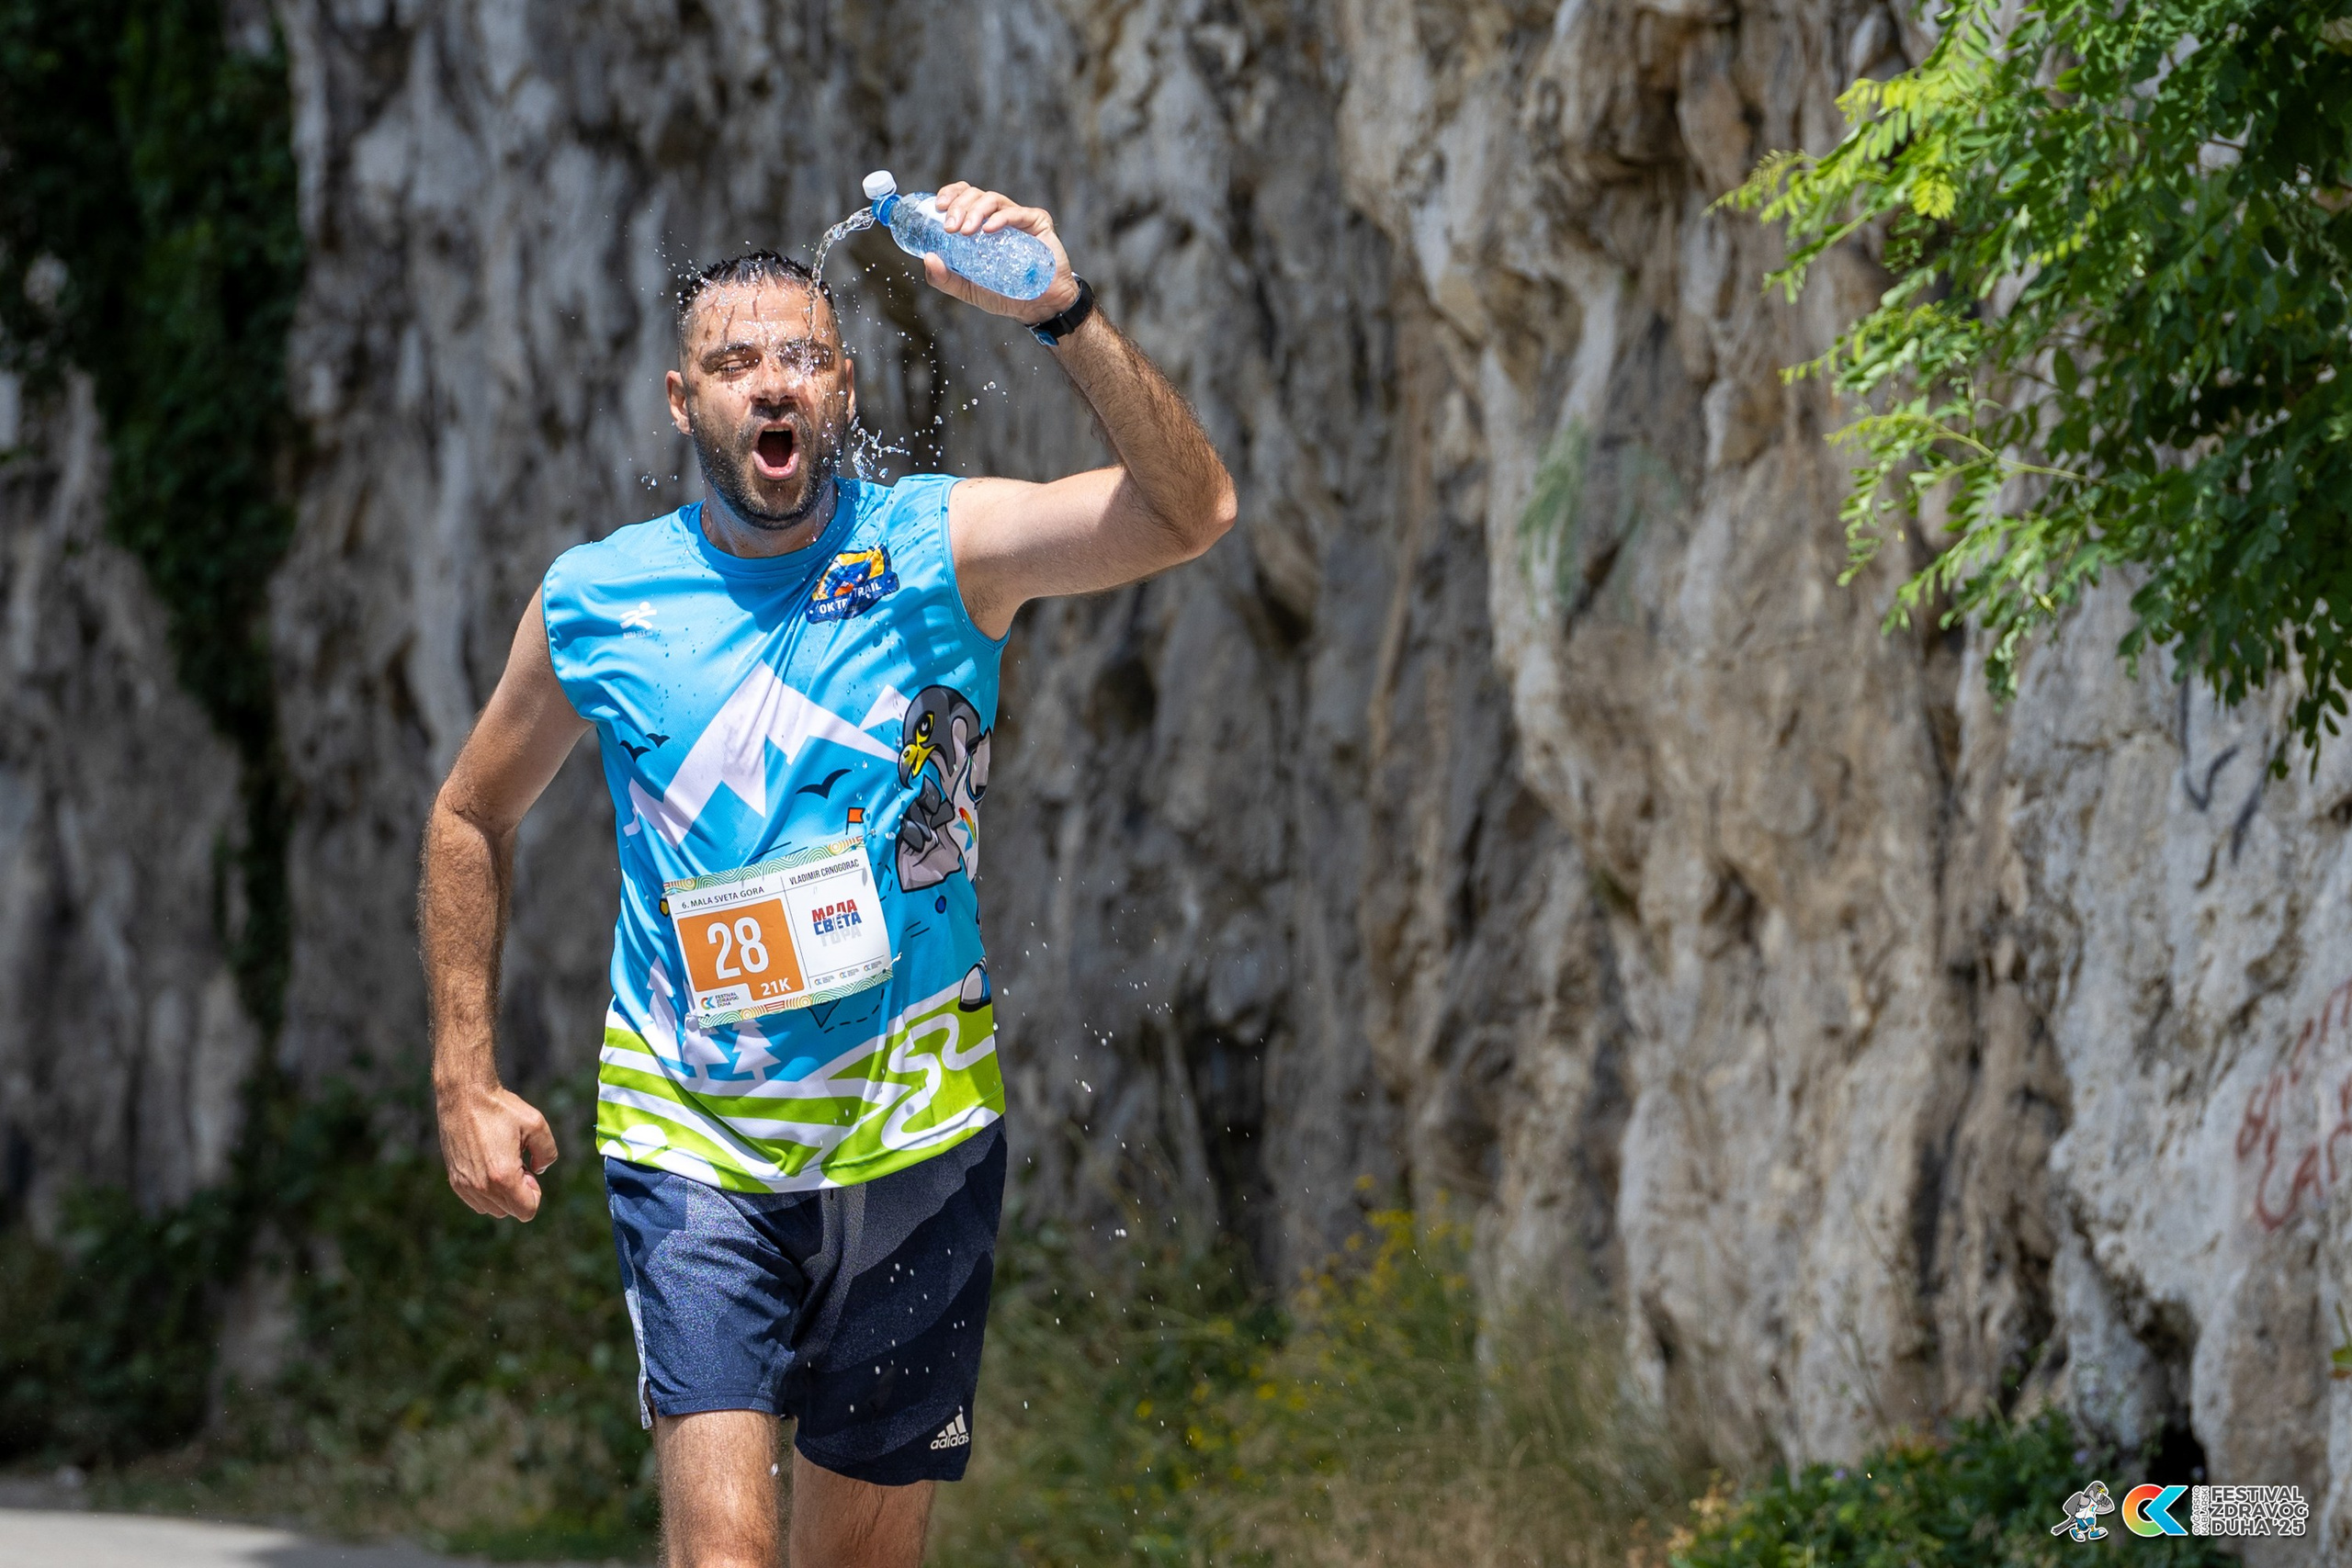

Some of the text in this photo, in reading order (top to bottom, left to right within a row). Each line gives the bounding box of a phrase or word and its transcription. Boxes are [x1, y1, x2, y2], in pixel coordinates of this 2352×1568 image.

[789, 859, 860, 886] VLADIMIR CRNOGORAC
[682, 886, 765, 909] 6. MALA SVETA GORA
[707, 917, 769, 980] 28
[760, 977, 792, 997] 21K
[930, 1432, 969, 1450] adidas
